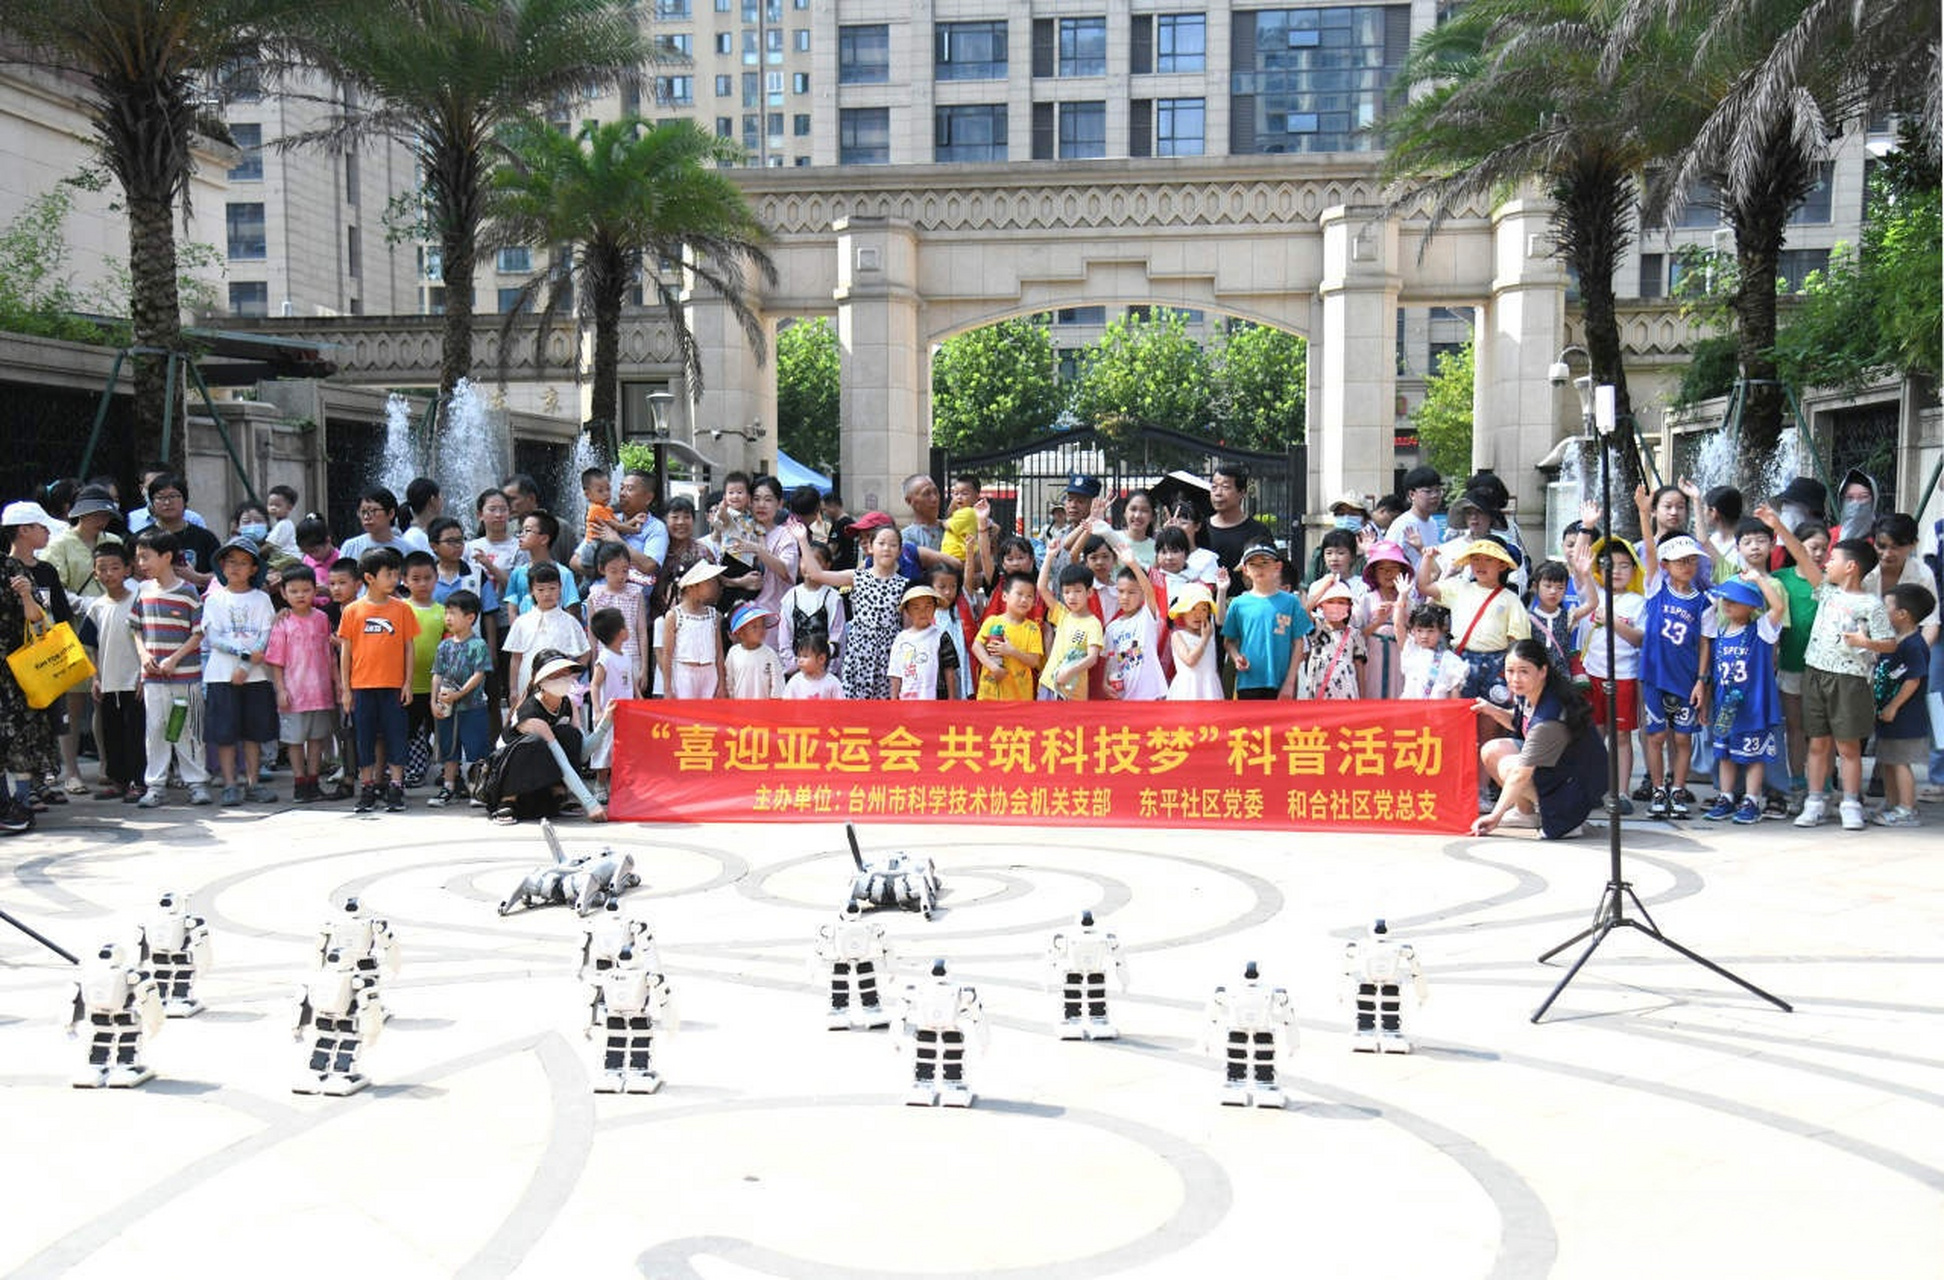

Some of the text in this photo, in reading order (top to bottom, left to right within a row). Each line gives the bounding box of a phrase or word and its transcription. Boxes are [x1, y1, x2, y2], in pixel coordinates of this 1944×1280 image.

[1662, 618, 1687, 644] 23
[1720, 660, 1747, 684] 23
[651, 724, 924, 773] “喜迎亚运会
[1742, 737, 1760, 752] 23
[1139, 787, 1265, 819] 东平社区党委
[1287, 789, 1438, 821] 和合社区党总支
